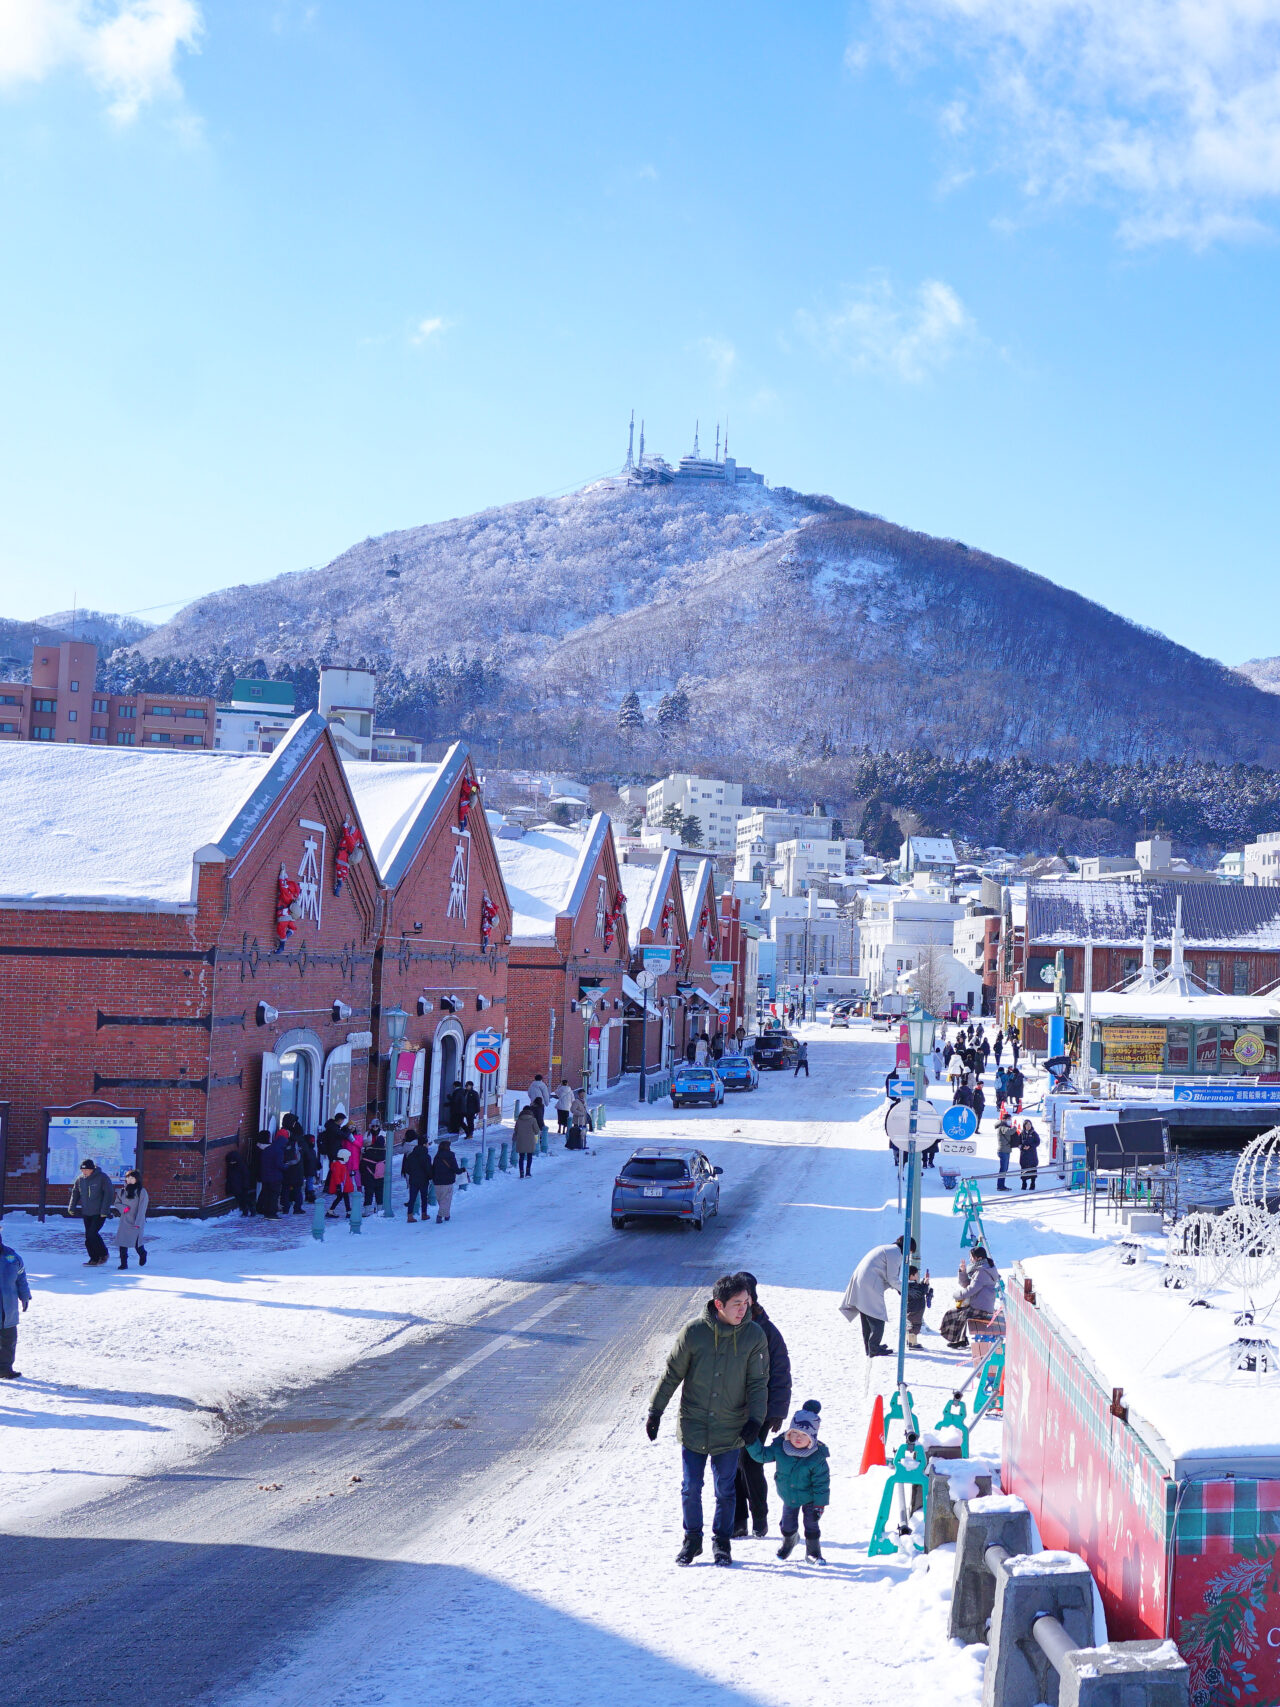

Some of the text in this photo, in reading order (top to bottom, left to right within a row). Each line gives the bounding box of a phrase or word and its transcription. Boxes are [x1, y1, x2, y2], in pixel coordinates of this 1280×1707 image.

[1194, 1093, 1234, 1102] Bluemoon
[943, 1144, 975, 1154] ここから
